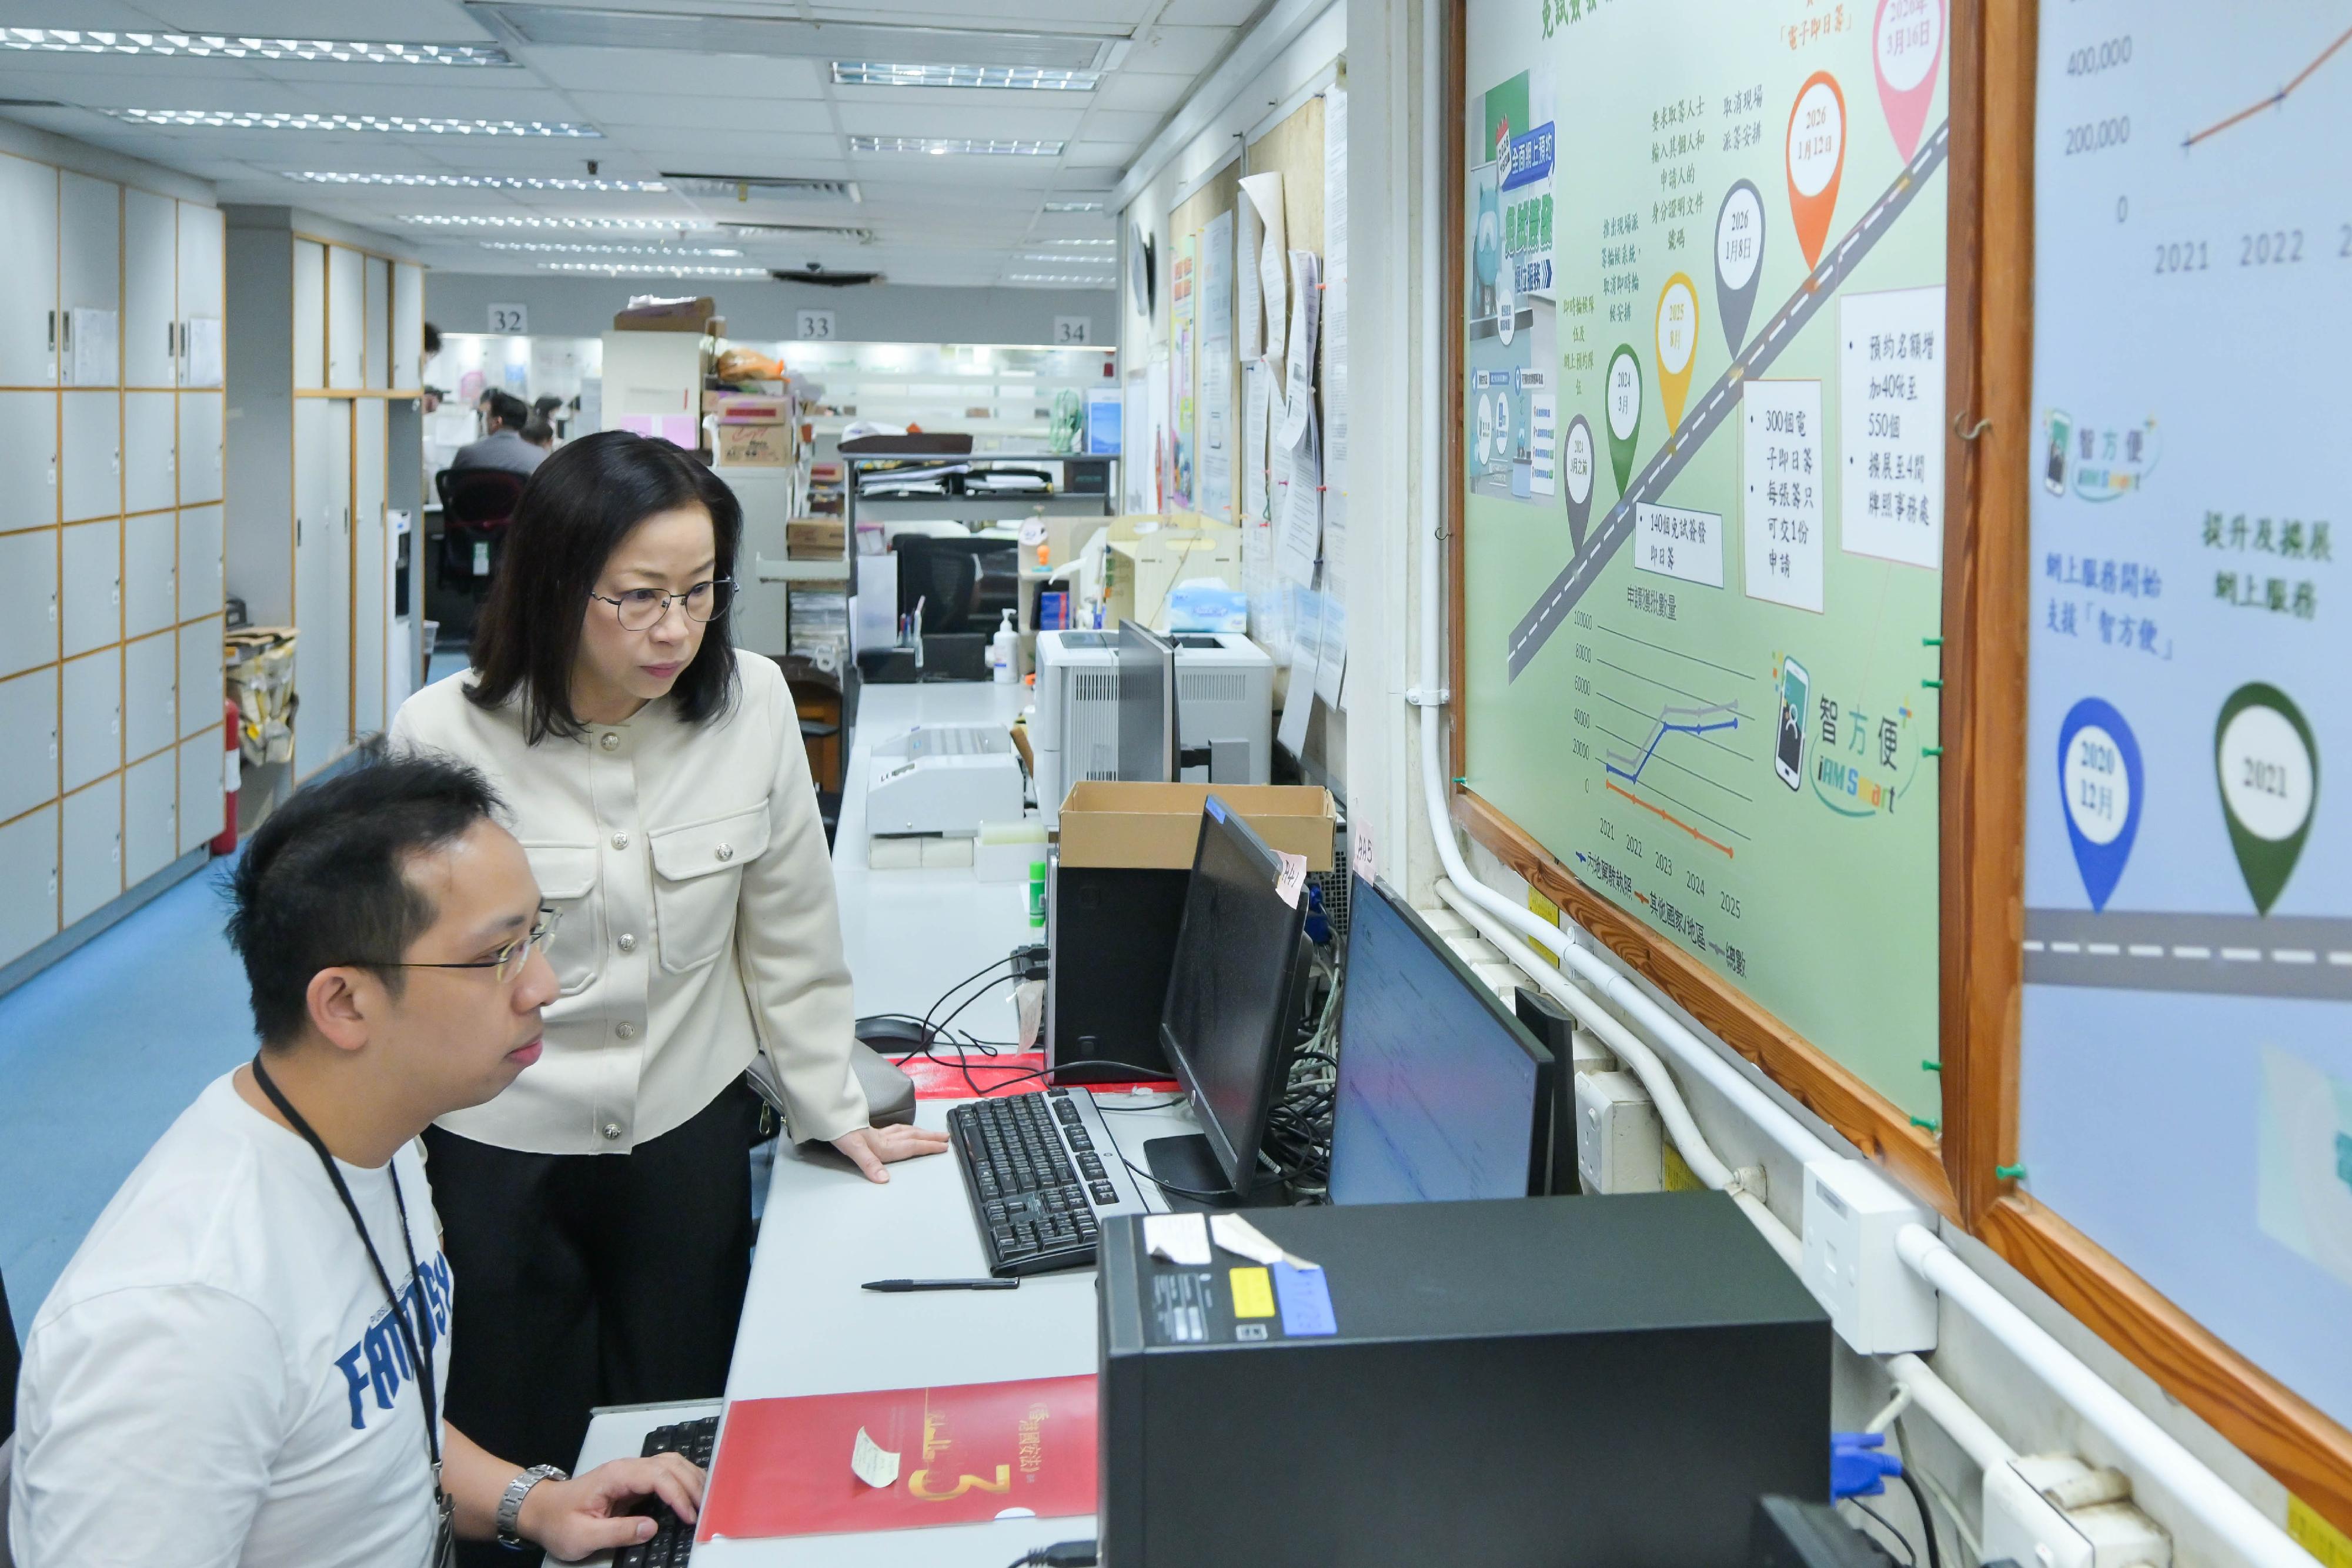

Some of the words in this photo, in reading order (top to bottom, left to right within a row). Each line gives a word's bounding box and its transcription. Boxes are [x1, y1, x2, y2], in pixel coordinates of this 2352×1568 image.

[1887, 19, 1930, 56] 3月16日
[2067, 35, 2133, 76] 400,000
[1723, 83, 1762, 118] 取消現場
[1806, 106, 1826, 129] 2026
[1798, 135, 1832, 160] 1月12日
[2065, 116, 2130, 156] 200,000
[1512, 132, 1552, 175] 全面網上預約
[1661, 162, 1695, 192] 申請人的
[1732, 209, 1749, 231] 2026
[2117, 195, 2129, 223] 0
[1726, 237, 1751, 263] 1月8日
[2153, 240, 2210, 275] 2021
[2239, 230, 2305, 267] 2022
[495, 310, 522, 331] 32
[1669, 304, 1684, 320] 2025
[803, 317, 828, 338] 33
[1060, 323, 1084, 342] 34
[1670, 329, 1680, 349] 8月
[1618, 372, 1631, 387] 2024
[1618, 395, 1628, 414] 3月
[1766, 410, 1806, 437] 300個電
[1868, 412, 1900, 439] 550個
[1574, 440, 1583, 453] 2024
[1768, 517, 1809, 544] 可交1份
[1769, 549, 1790, 579] 申請
[1627, 584, 1676, 621] 申請獲批數量
[1574, 610, 1592, 630] 100000
[1575, 643, 1591, 663] 80000
[1575, 675, 1591, 696] 60000
[1573, 708, 1589, 729] 40000
[1820, 693, 1897, 771] 智方便
[1573, 738, 1589, 760] 20000
[2080, 740, 2115, 776] 2020
[1585, 778, 1589, 793] 0
[2243, 757, 2289, 799] 2021
[2080, 779, 2113, 822] 12月
[1357, 834, 1372, 863] AA5
[1600, 817, 1615, 841] 2021
[1626, 834, 1642, 858] 2022
[1655, 851, 1672, 877] 2023
[1686, 871, 1705, 897] 2024
[1720, 891, 1741, 919] 2025
